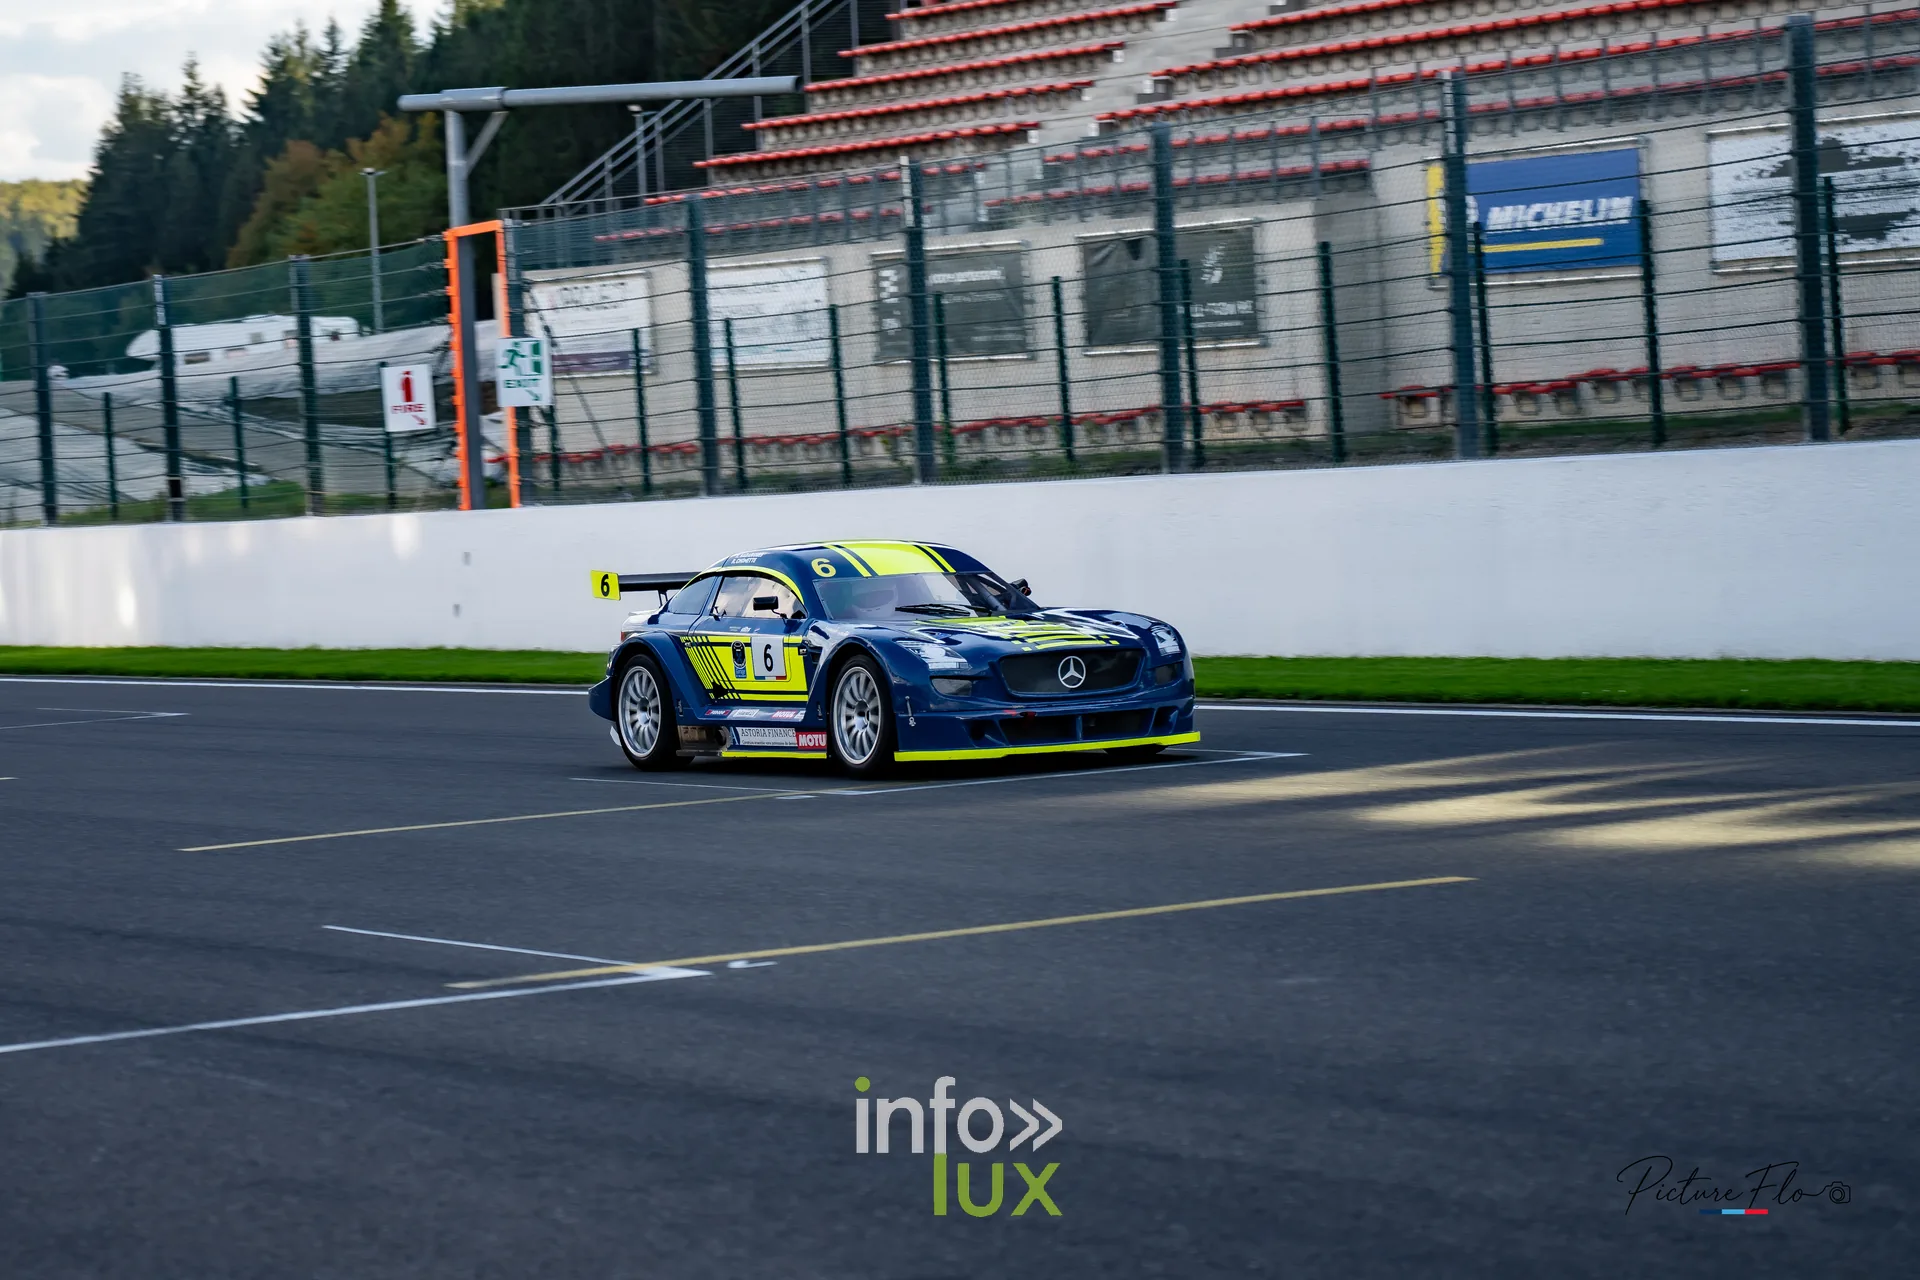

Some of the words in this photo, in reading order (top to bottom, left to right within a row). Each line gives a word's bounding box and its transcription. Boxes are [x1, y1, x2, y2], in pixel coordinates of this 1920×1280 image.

[1486, 196, 1634, 234] MICHELIN
[504, 378, 541, 389] EXIT
[391, 403, 426, 413] FIRE
[811, 557, 837, 578] 6
[600, 573, 610, 597] 6
[763, 643, 774, 672] 6
[741, 728, 767, 738] ASTORIA
